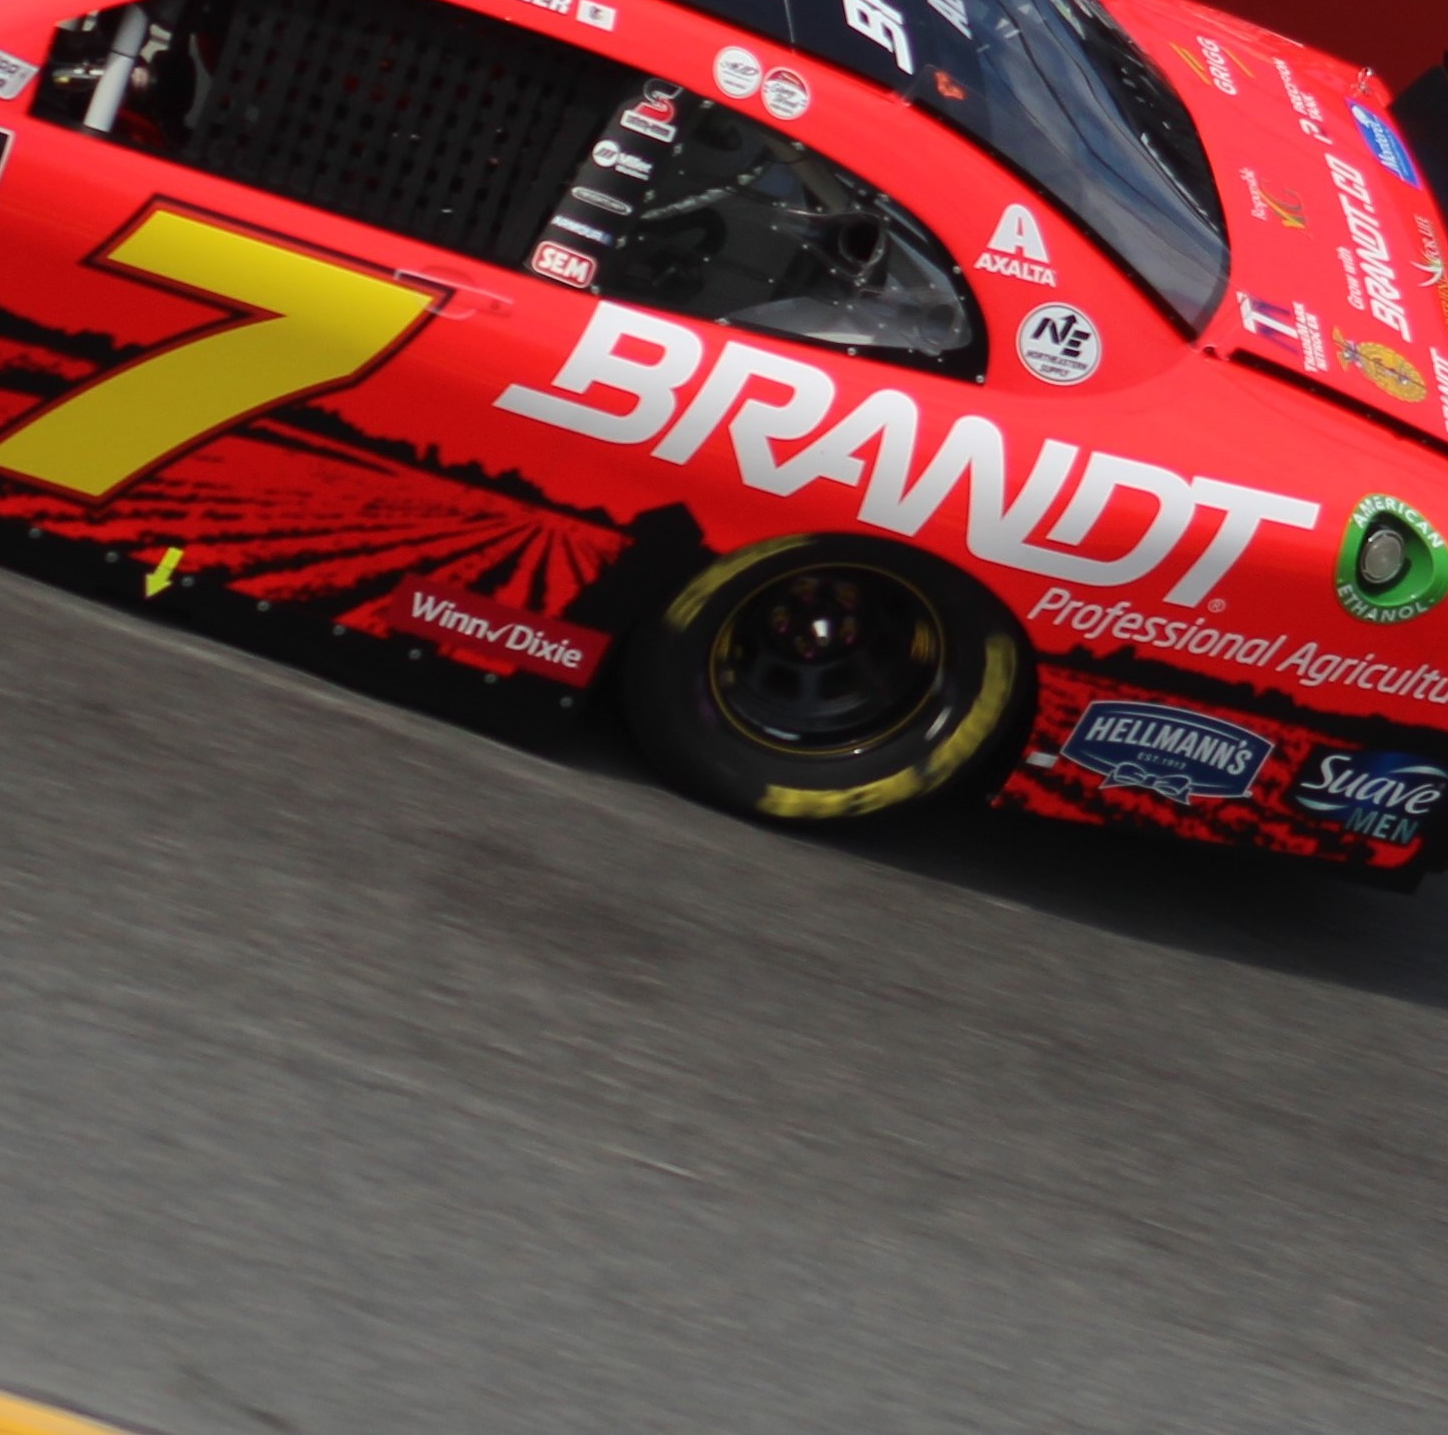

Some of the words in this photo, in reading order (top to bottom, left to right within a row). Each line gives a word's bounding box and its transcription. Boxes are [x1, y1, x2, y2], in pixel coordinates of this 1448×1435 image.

[1197, 35, 1238, 96] GRIGG
[538, 246, 591, 283] SEM
[973, 252, 1057, 288] AXALTA
[492, 299, 1321, 608] BRANDT
[1353, 495, 1444, 548] AMERICAN
[1027, 586, 1283, 667] Professional
[1337, 584, 1428, 622] ETHANOL
[1084, 716, 1253, 776] HELLMANN'S
[1300, 755, 1441, 814] Suave
[1344, 807, 1419, 845] MEN
